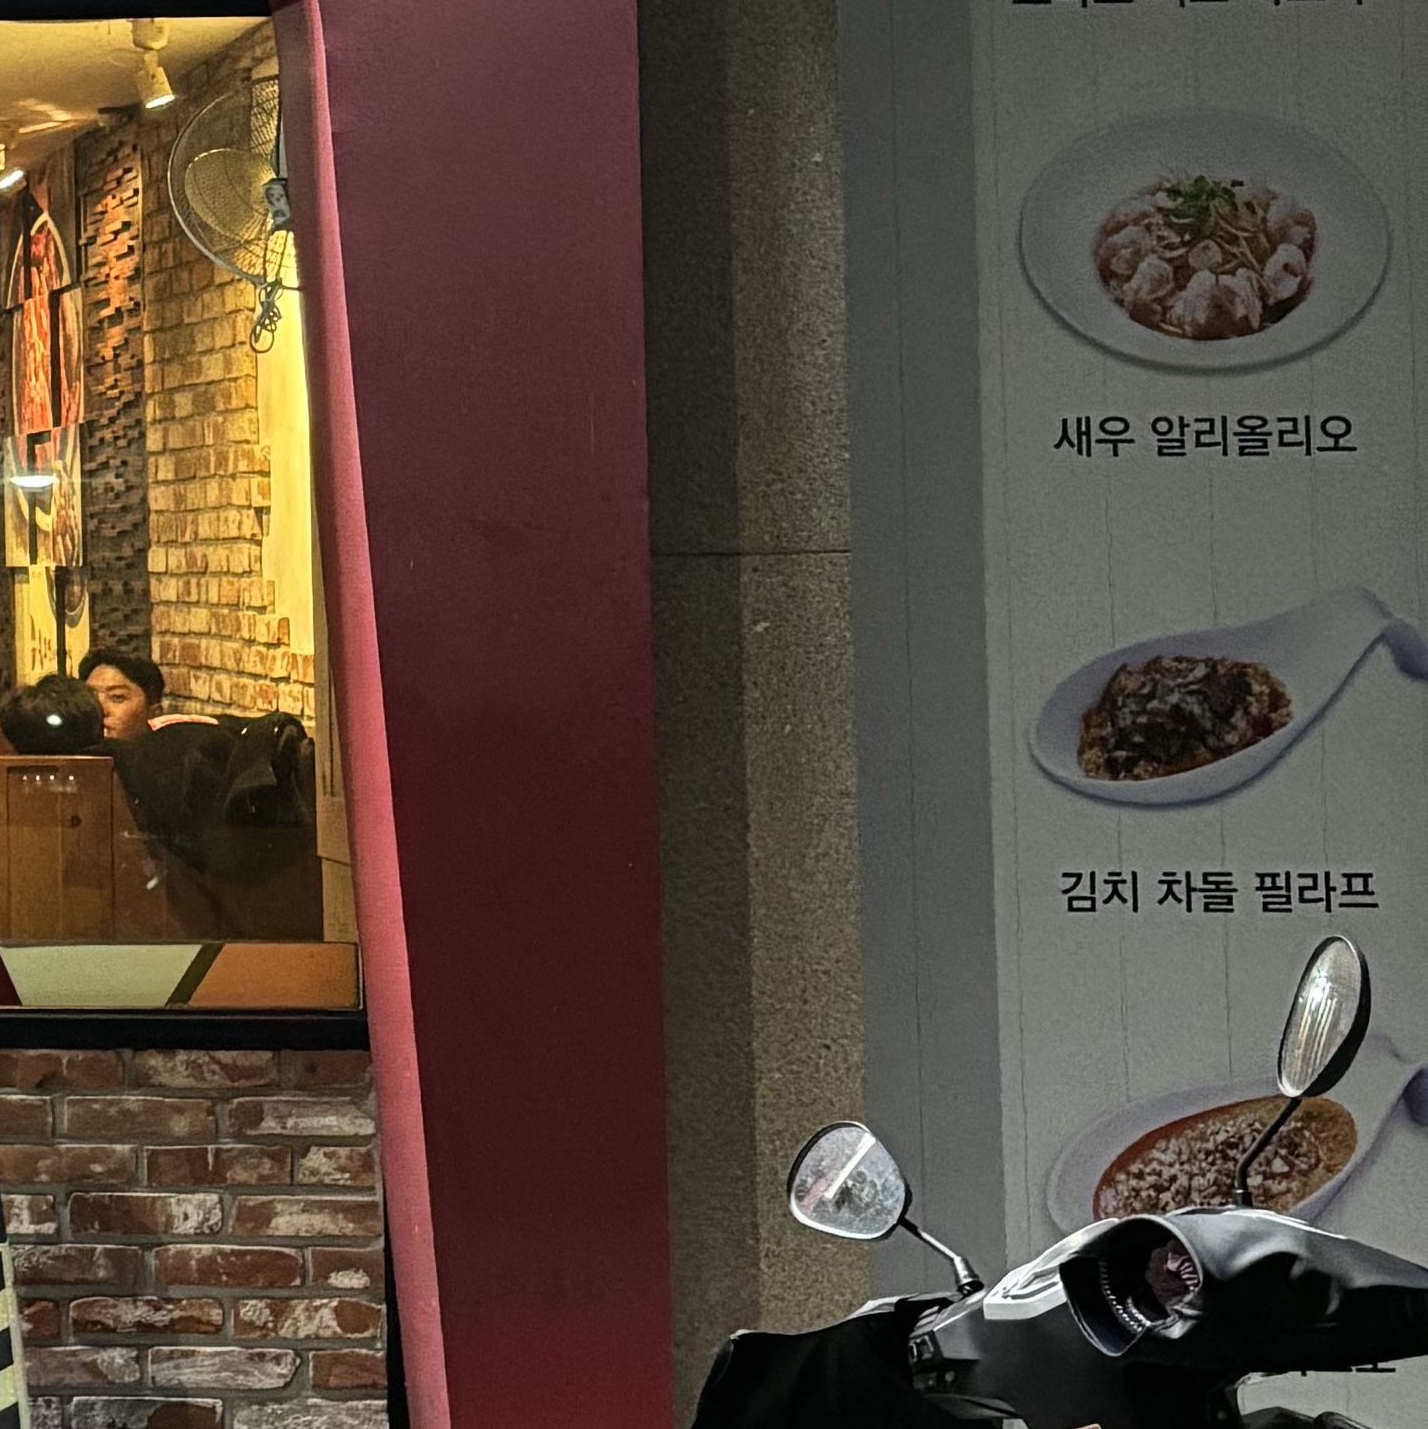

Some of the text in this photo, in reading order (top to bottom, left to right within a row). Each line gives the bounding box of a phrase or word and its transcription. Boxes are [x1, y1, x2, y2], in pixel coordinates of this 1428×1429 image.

[1053, 414, 1358, 458] 새우 알리올리오
[1060, 869, 1381, 914] 김치 차돌 필라프
